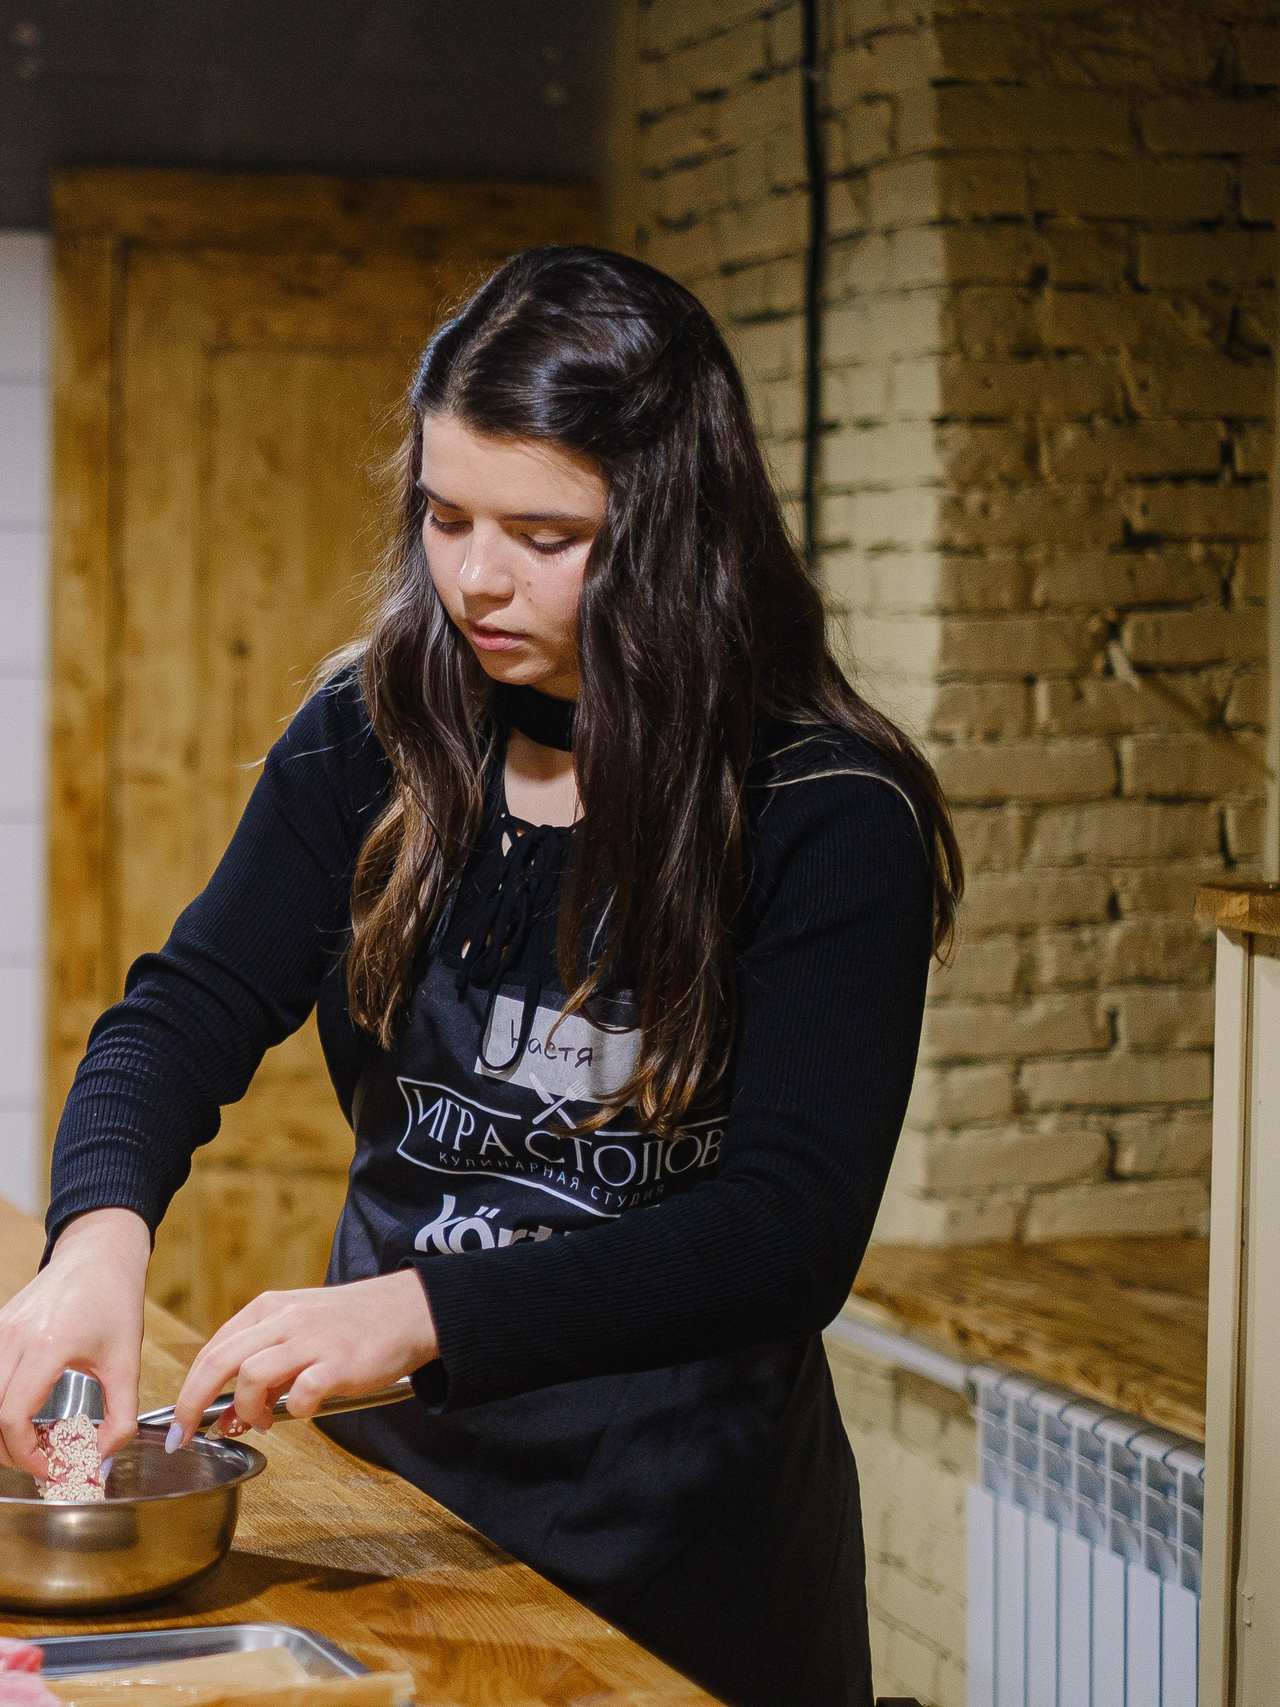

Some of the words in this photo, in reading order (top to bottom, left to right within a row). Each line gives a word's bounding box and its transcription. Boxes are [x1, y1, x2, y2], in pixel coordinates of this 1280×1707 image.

[412, 1088, 514, 1157] ИГРА
[524, 1129, 724, 1187] СТОЛОВ
[439, 1151, 579, 1191] КУЛИНАРНАЯ
[590, 1184, 665, 1208] СТУДИЯ
